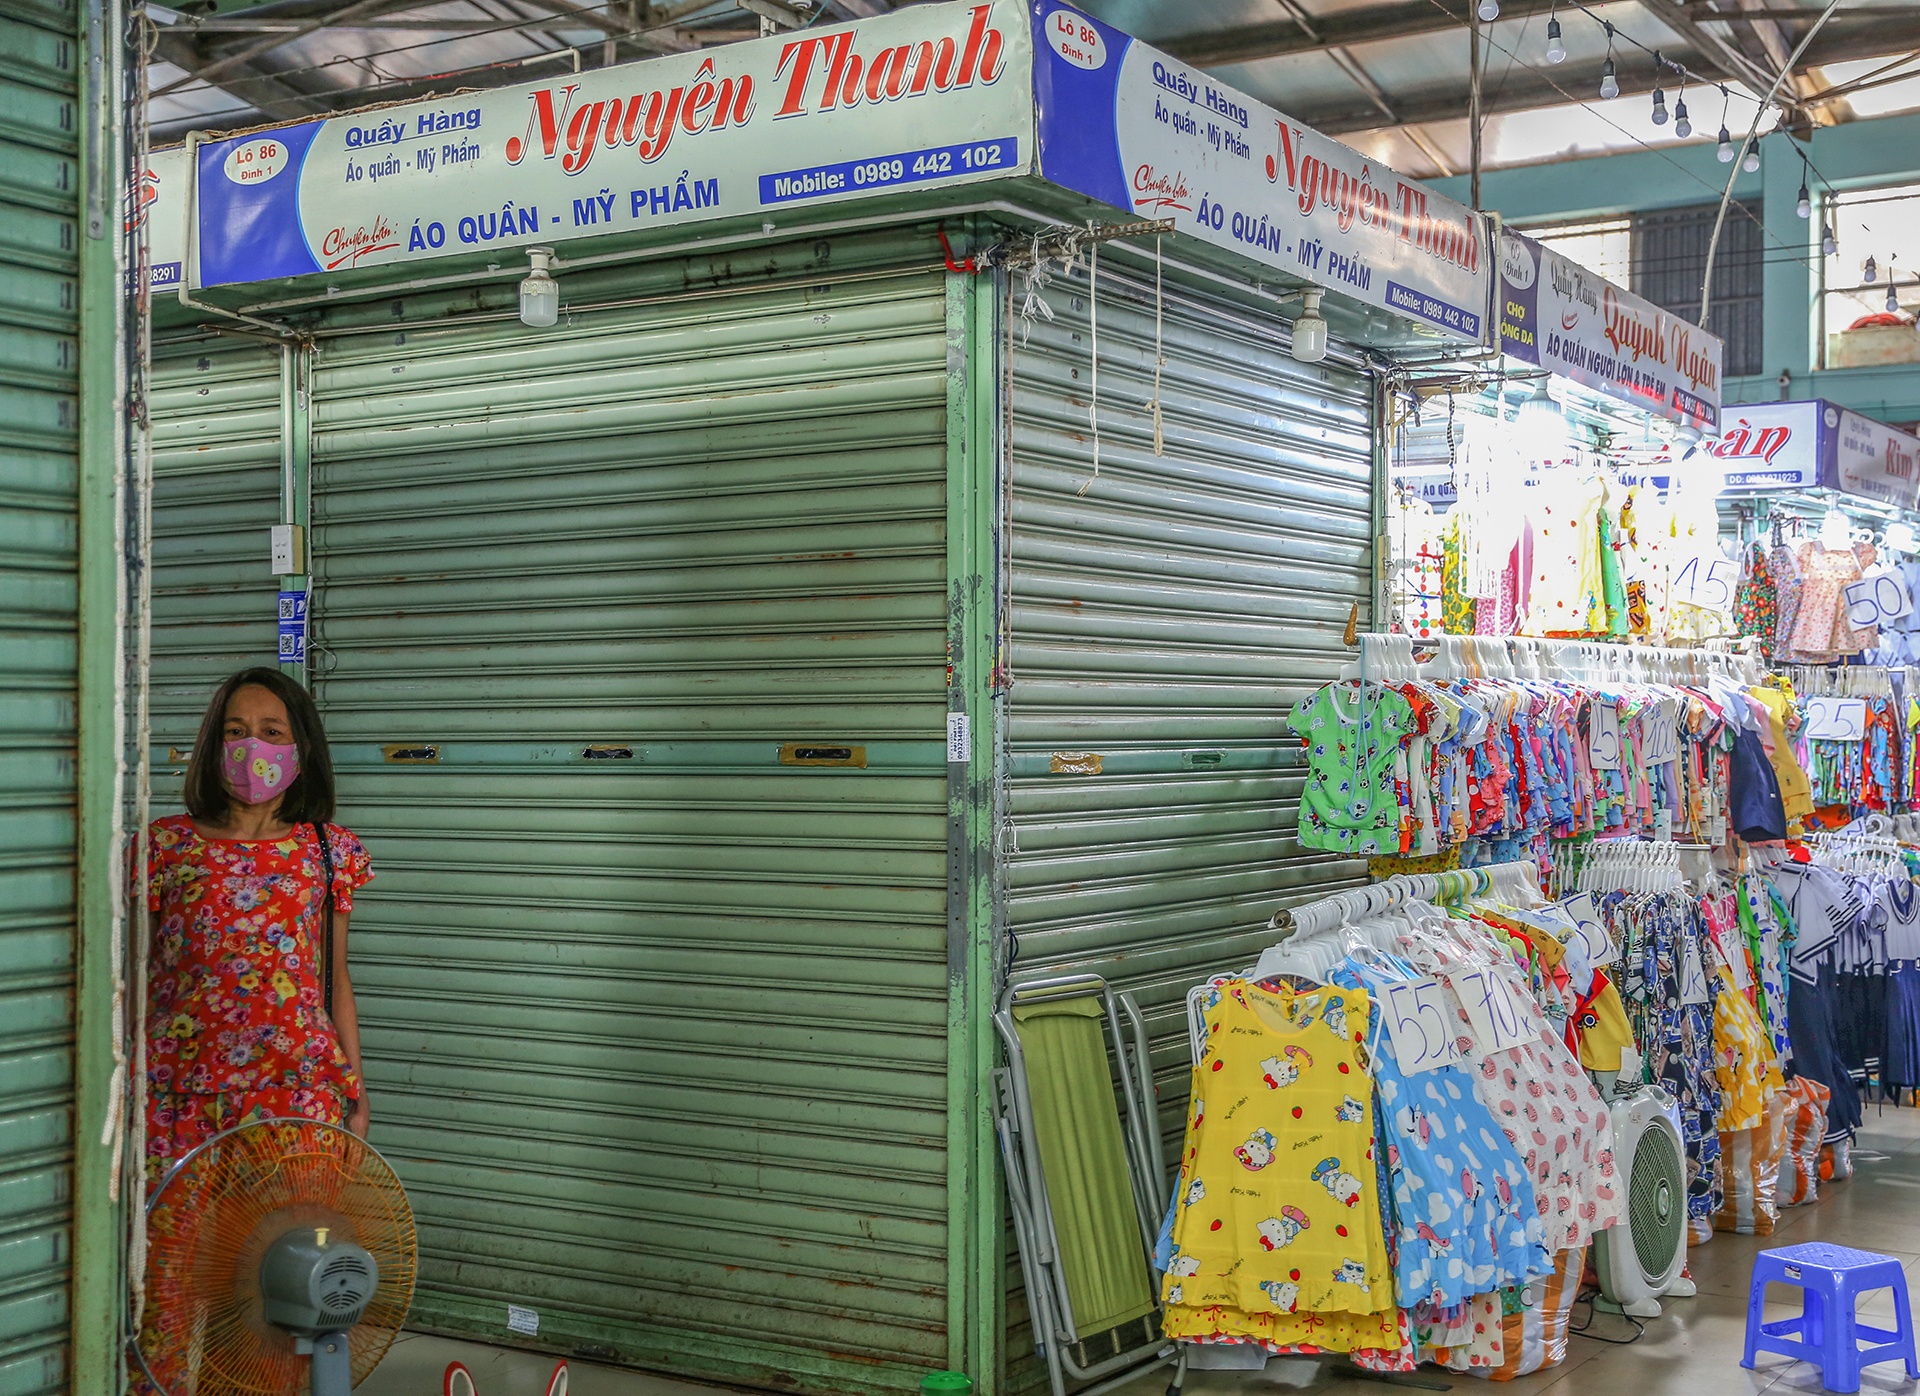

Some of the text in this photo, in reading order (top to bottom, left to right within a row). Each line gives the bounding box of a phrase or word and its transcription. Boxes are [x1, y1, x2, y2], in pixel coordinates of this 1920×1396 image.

[1057, 15, 1096, 46] Lô 86
[1061, 41, 1093, 65] Đình 1
[505, 3, 1006, 175] Nguyên Thanh
[1152, 60, 1248, 128] Quầy Hàng
[345, 108, 481, 146] Quầy Hàng
[1154, 93, 1169, 122] Áo
[1172, 105, 1196, 137] quần
[1207, 118, 1221, 152] Mỹ
[1224, 127, 1251, 160] Phẩm
[236, 144, 277, 164] Lô 86
[241, 166, 273, 181] Đình 1
[345, 157, 363, 183] Áo
[369, 152, 401, 183] quần
[417, 147, 436, 173] Mỹ
[442, 136, 480, 165] Phẩm
[775, 145, 1001, 198] Mobile: 0989 442 102
[408, 217, 446, 252] ÁO
[458, 200, 539, 244] QUẦN
[573, 188, 616, 226] MỸ
[630, 170, 720, 218] PHẨM
[1265, 119, 1479, 275] Nguyên Thanh
[1196, 191, 1225, 231] ÁO
[1230, 213, 1281, 255] QUẦN
[1297, 238, 1324, 276] MỸ
[1327, 248, 1372, 291] PHẨM
[1391, 287, 1475, 333] Mobile: 0989 442 102
[1500, 317, 1520, 341] ỐNG
[1546, 328, 1561, 360] ÁO
[1604, 286, 1717, 391] Quỳnh Ngân
[1845, 577, 1903, 625] 50
